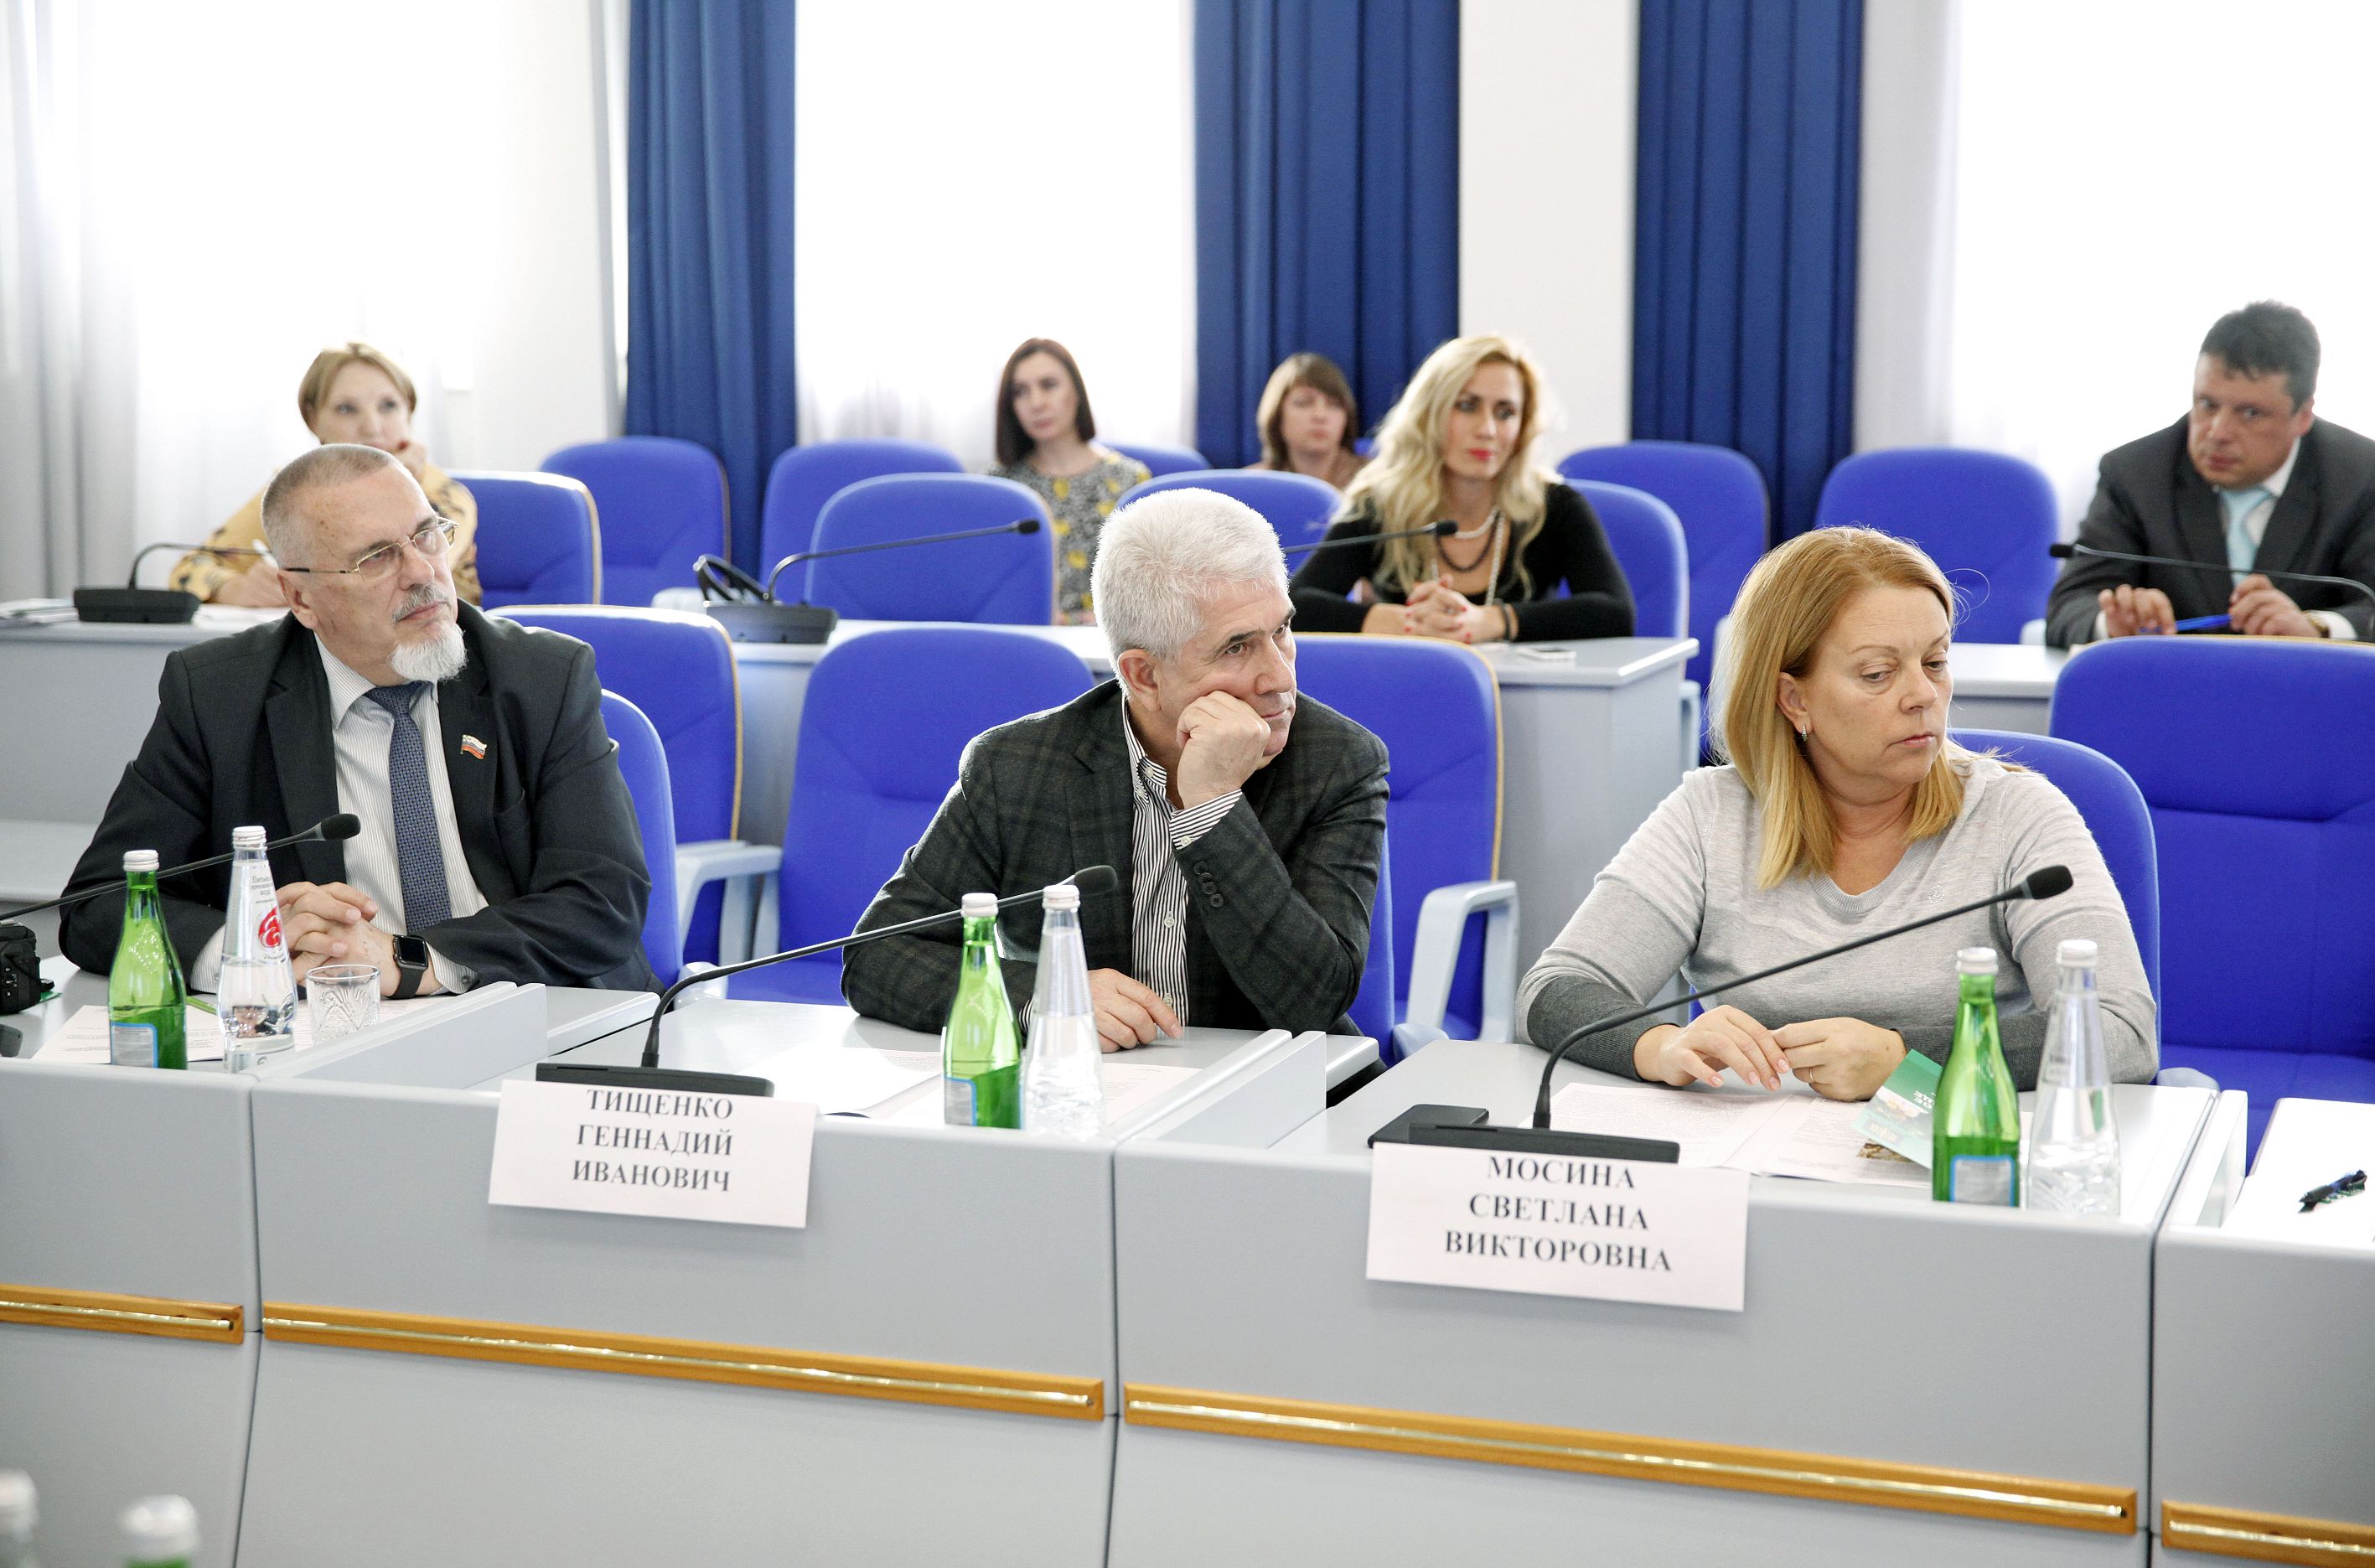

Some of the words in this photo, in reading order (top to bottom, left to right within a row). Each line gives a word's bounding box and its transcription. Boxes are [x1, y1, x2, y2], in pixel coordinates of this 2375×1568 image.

[587, 1089, 733, 1120] ТИЩЕНКО
[576, 1124, 733, 1156] ГЕННАДИЙ
[572, 1160, 731, 1192] ИВАНОВИЧ
[1487, 1156, 1635, 1188] МОСИНА
[1469, 1193, 1649, 1229] СВЕТЛАНА
[1444, 1230, 1673, 1271] ВИКТОРОВНА
